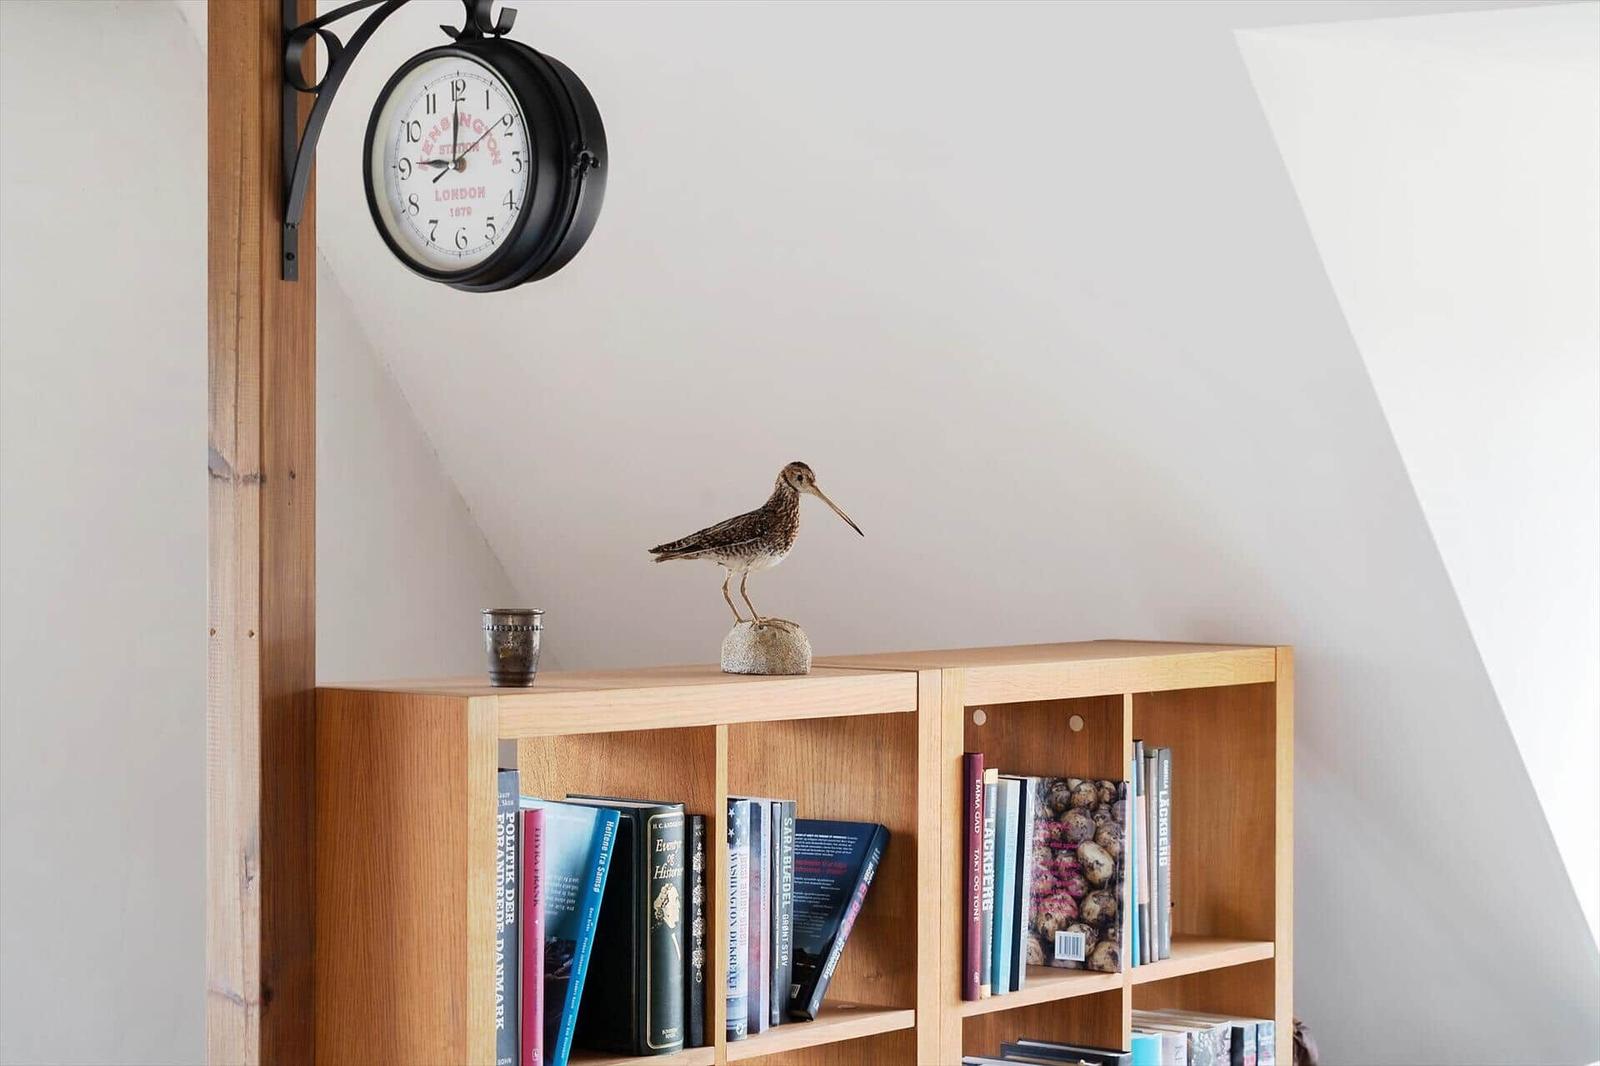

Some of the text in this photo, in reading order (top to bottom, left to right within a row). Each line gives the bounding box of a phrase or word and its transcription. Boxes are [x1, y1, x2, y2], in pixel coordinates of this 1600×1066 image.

[451, 79, 466, 101] 12
[426, 93, 437, 114] 11
[406, 120, 422, 143] 10
[502, 113, 514, 137] 2
[398, 157, 412, 180] 9
[511, 151, 522, 174] 3
[408, 193, 420, 216] 8
[435, 186, 485, 201] LONDON
[503, 189, 516, 210] 4
[428, 219, 438, 242] 7
[455, 227, 468, 250] 6
[485, 216, 496, 240] 5
[505, 811, 515, 884] POLITIK
[593, 820, 614, 893] Heltene fra Samsø
[782, 817, 792, 909] SARA BLÆDEL
[729, 853, 738, 928] WASHINGTON
[505, 888, 515, 925] DER
[496, 938, 504, 1030] DANMARK
